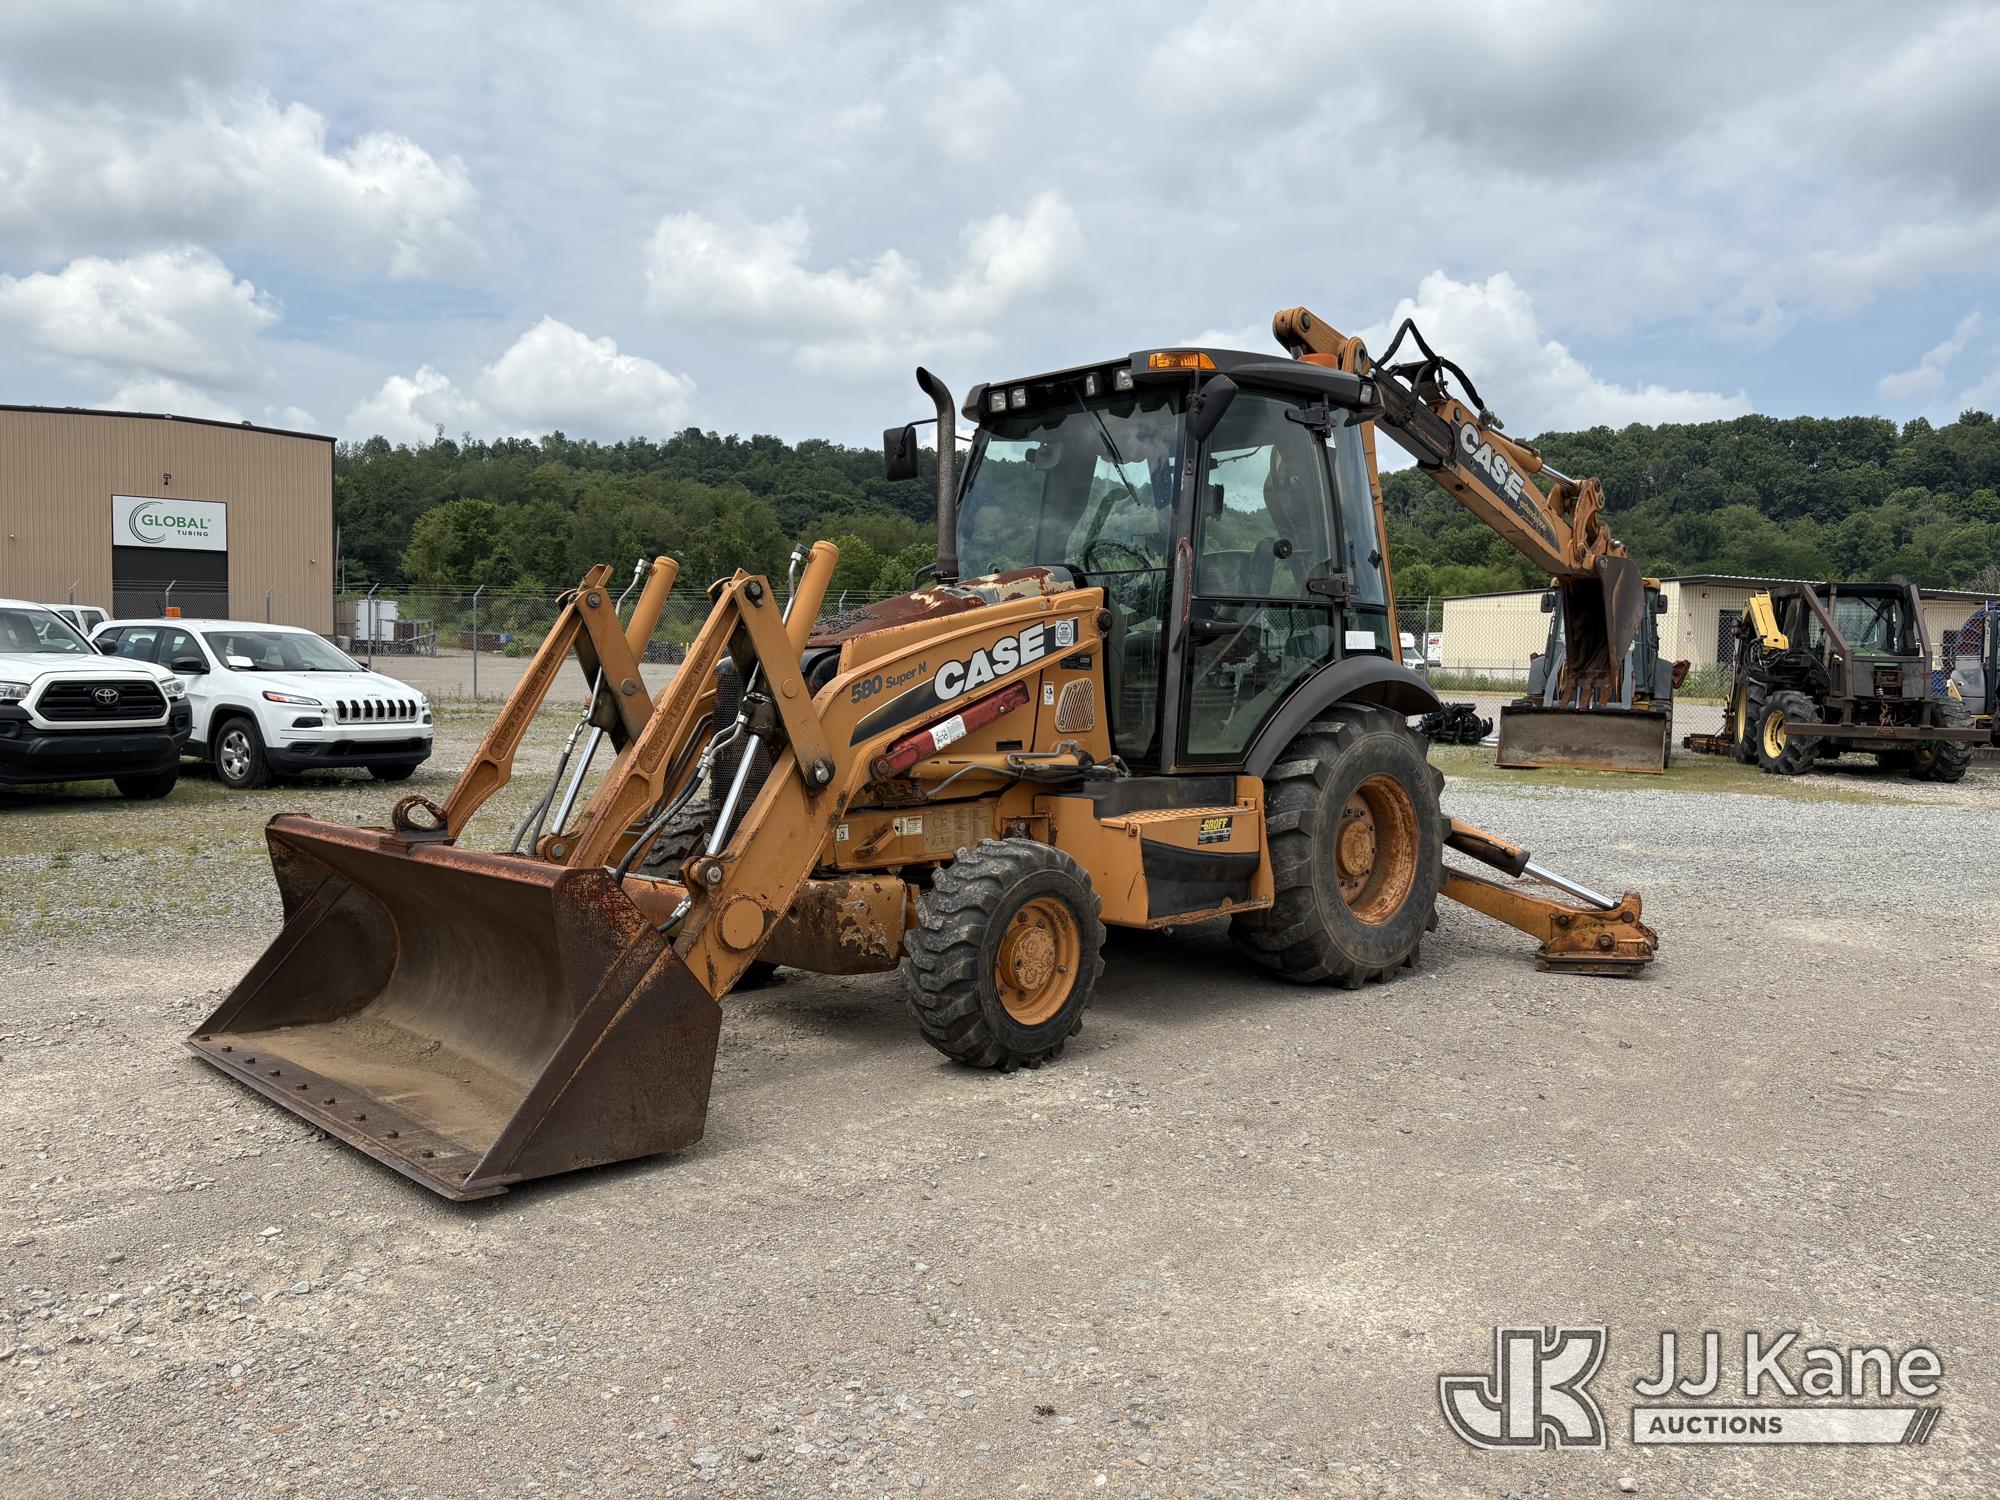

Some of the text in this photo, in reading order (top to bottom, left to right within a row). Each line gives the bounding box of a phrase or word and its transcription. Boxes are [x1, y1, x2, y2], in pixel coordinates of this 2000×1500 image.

[1460, 422, 1525, 502] CASE
[141, 514, 208, 529] GLOBAL
[851, 661, 927, 704] 580 Super N
[934, 622, 1045, 700] CASE
